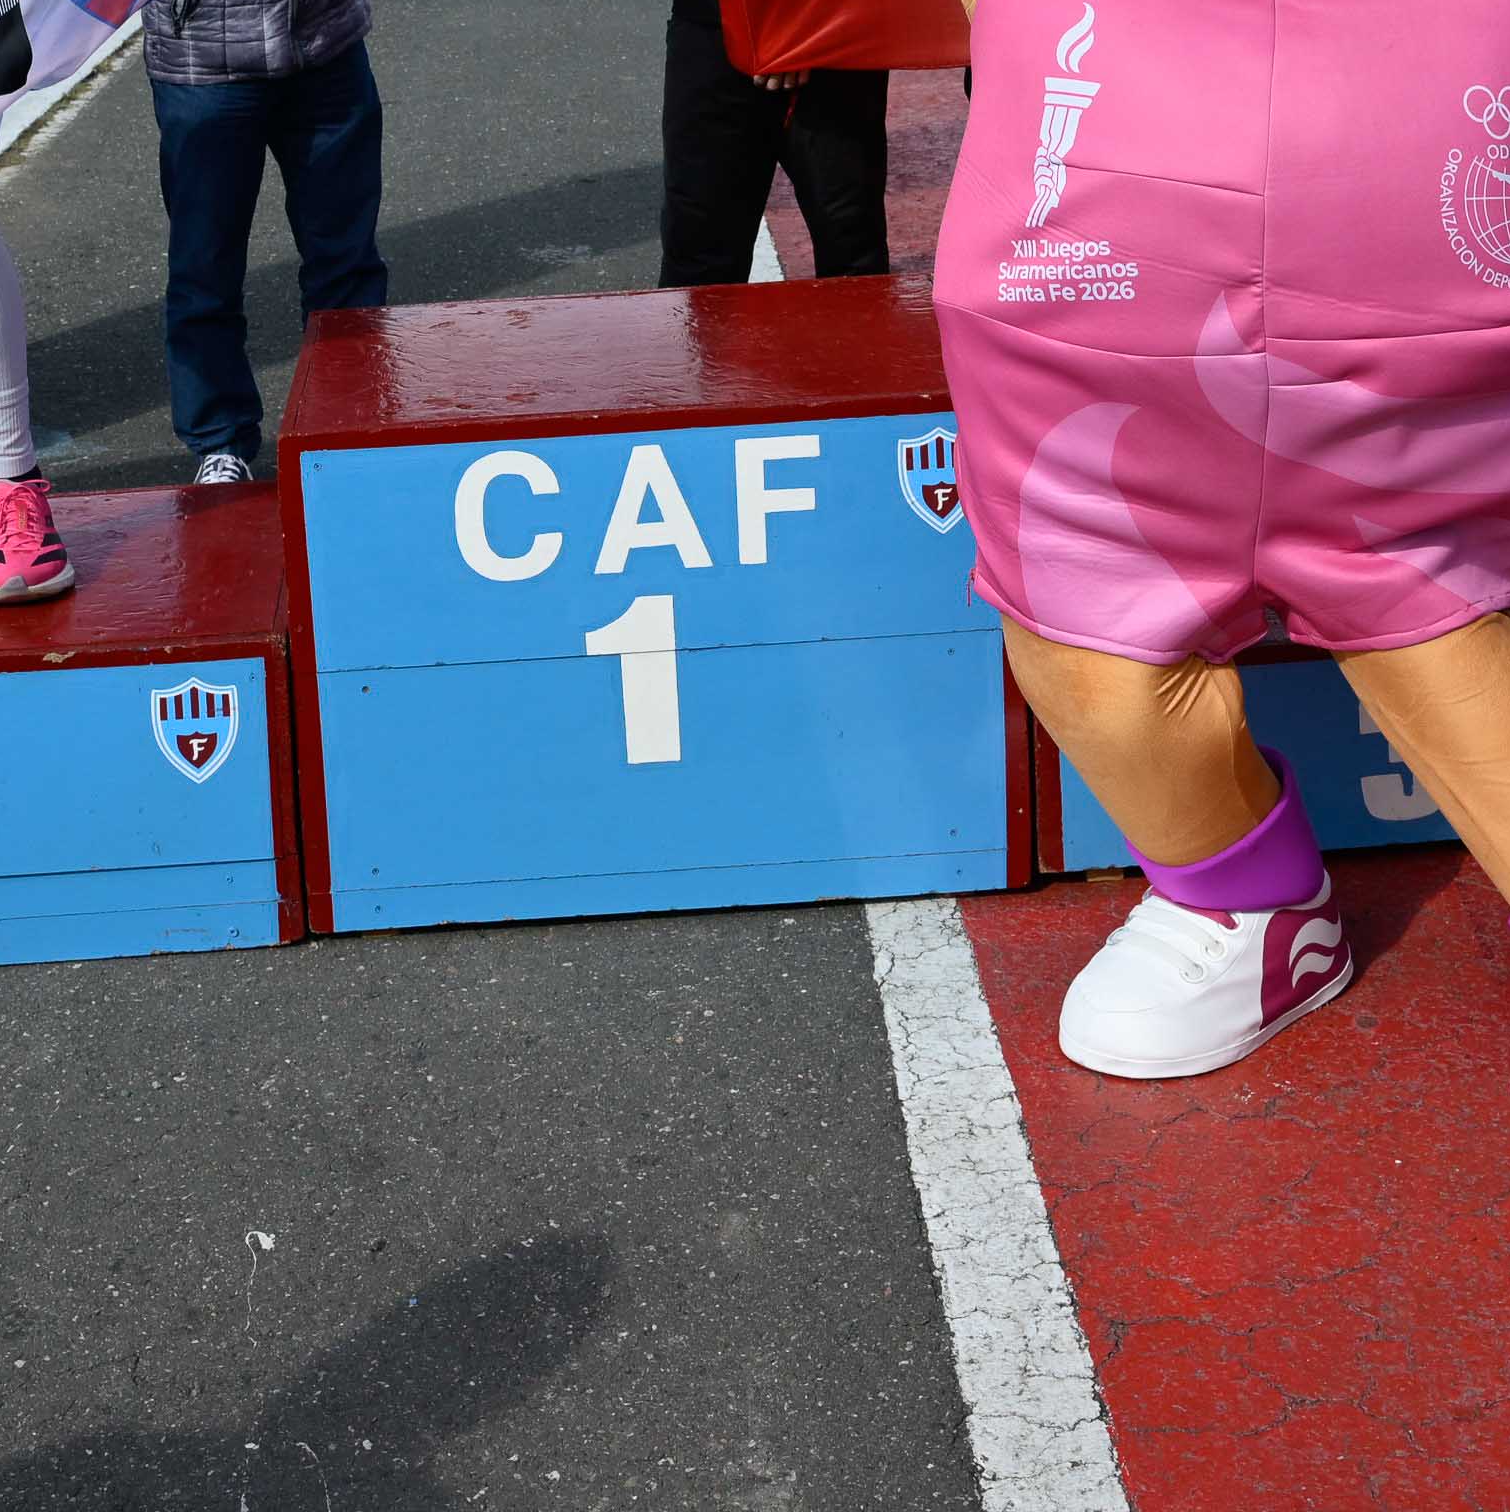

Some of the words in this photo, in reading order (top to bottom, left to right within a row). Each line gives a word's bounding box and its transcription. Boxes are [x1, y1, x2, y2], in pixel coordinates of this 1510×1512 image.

[1011, 239, 1037, 258] XIII
[1039, 239, 1111, 262] Juegos
[1439, 148, 1485, 277] ORGANIZACION
[997, 258, 1139, 280] Suramericanos
[997, 283, 1046, 302] Santa
[1048, 283, 1076, 302] Fe
[1077, 280, 1136, 301] 2026
[454, 434, 821, 582] CAF
[584, 593, 682, 766] 1
